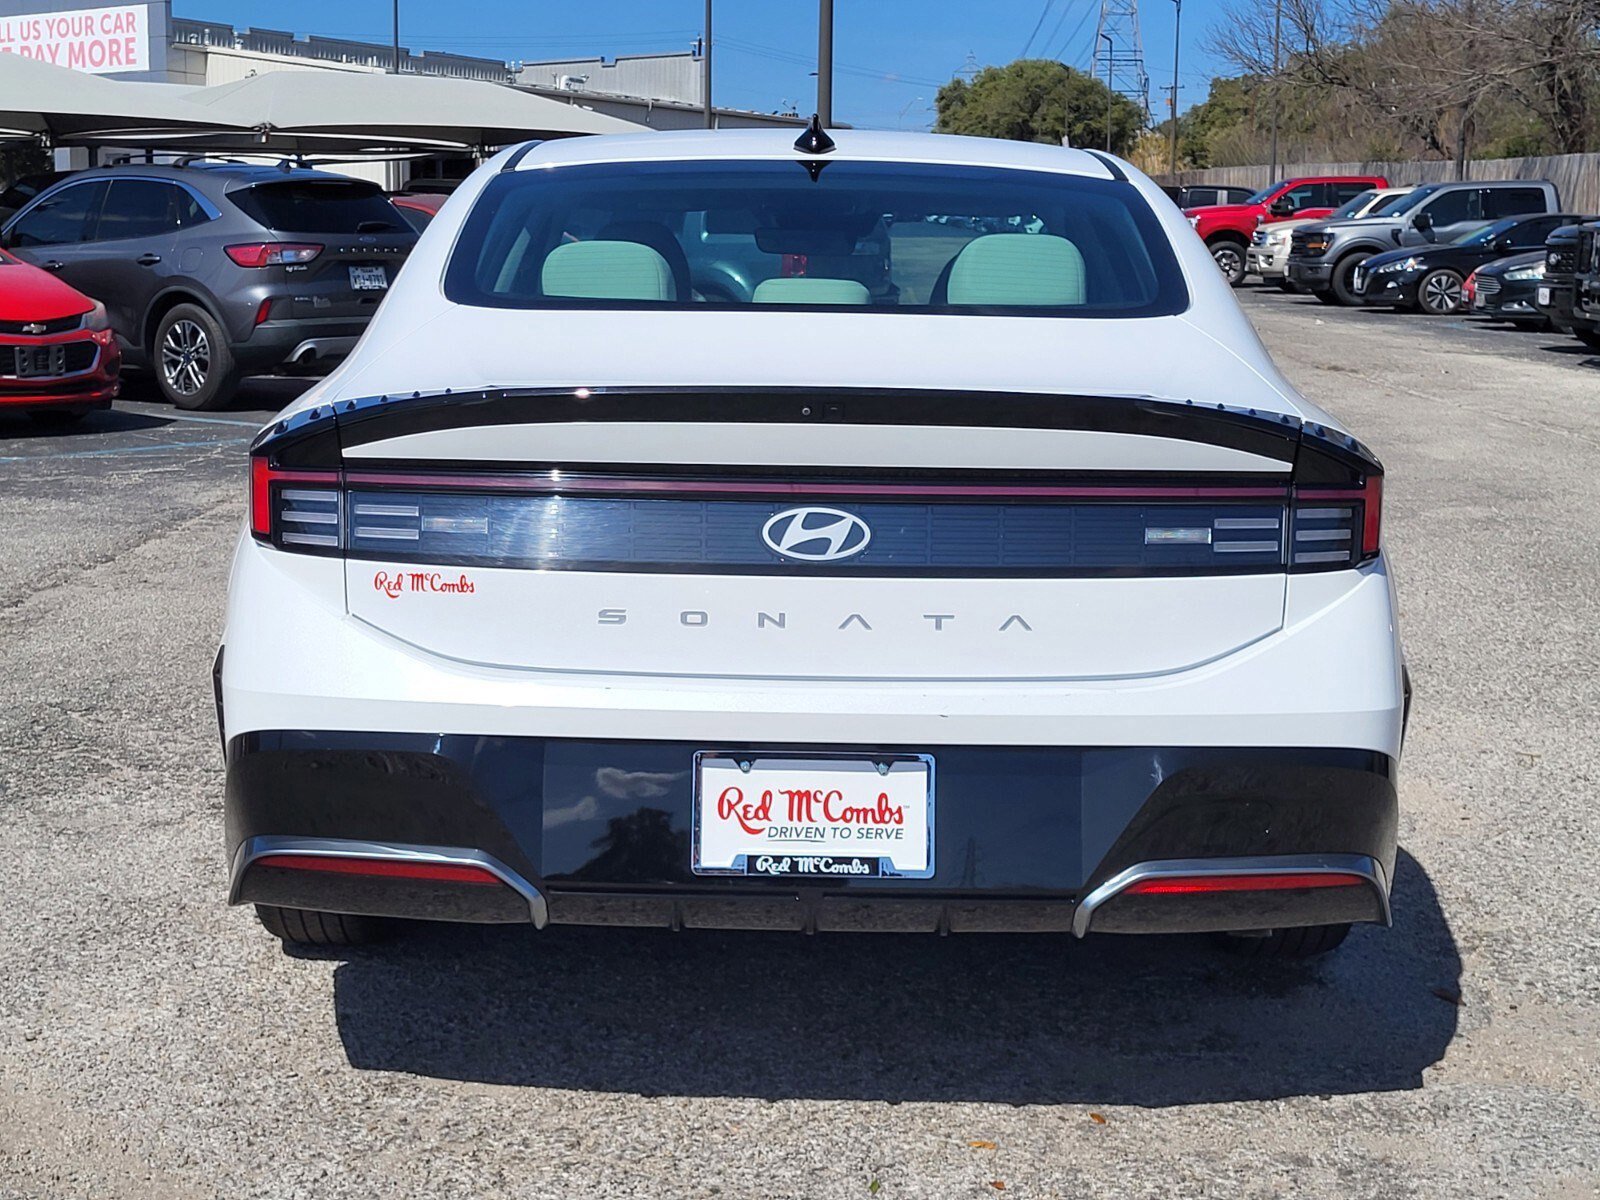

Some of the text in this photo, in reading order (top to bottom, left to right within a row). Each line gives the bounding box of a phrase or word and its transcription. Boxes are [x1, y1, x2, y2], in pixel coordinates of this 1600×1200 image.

[20, 20, 41, 41] US
[46, 15, 95, 39] YOUR
[100, 12, 137, 35] CAR
[68, 37, 137, 69] MORE
[374, 571, 475, 598] Red McCombs
[598, 608, 1033, 632] SONATA
[717, 786, 904, 835] Red McCombs
[767, 826, 904, 840] DRIVEN TO SERVE
[755, 855, 870, 875] Red McCombs
